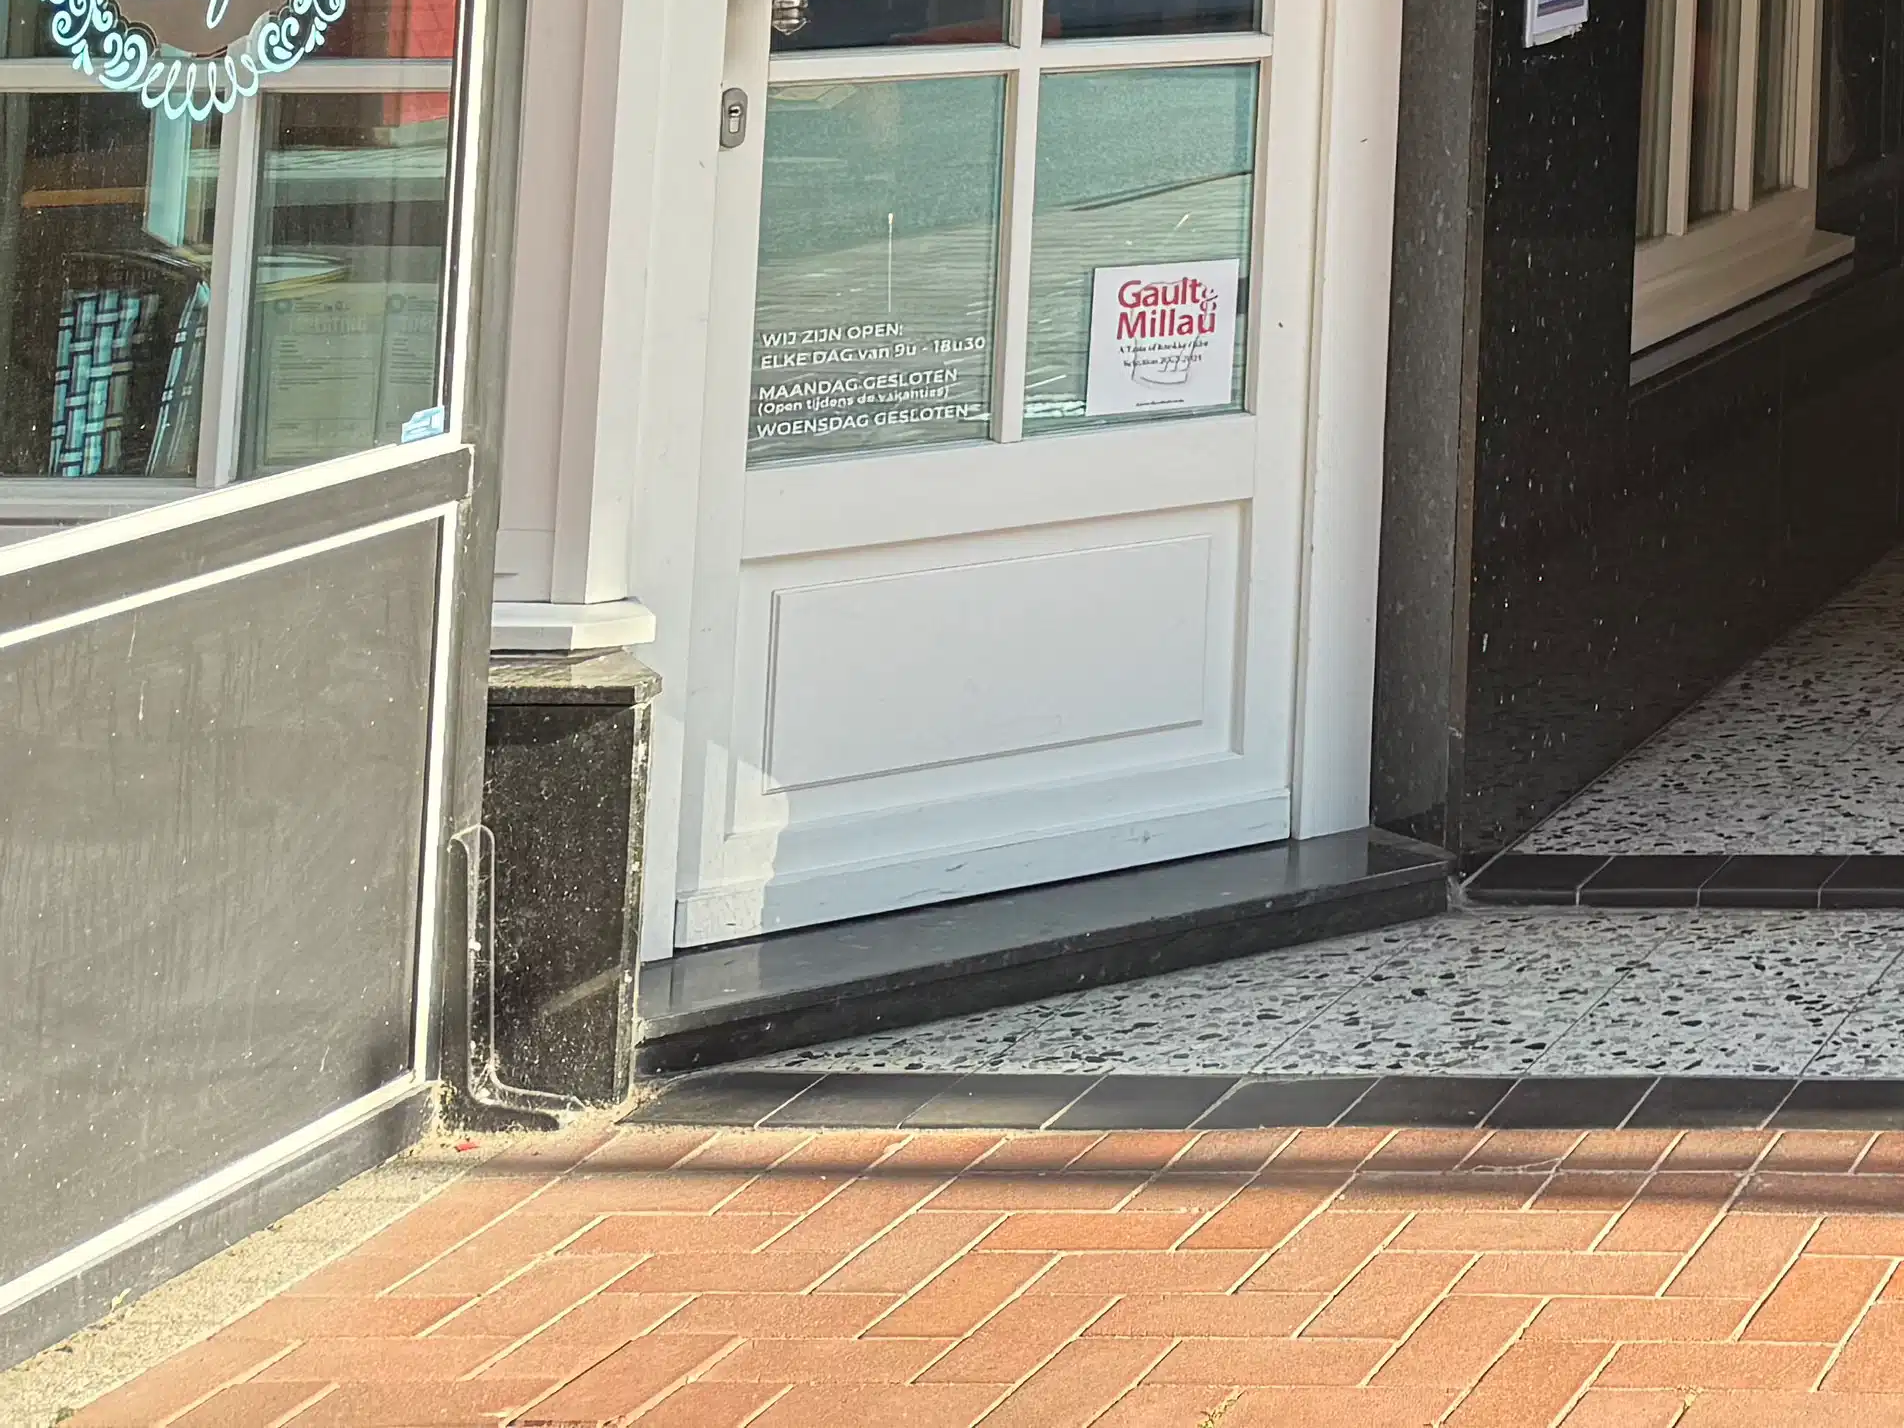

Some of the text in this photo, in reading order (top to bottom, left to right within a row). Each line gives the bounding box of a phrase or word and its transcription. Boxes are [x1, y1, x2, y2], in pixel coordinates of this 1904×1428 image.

[1117, 277, 1200, 309] Gault
[762, 332, 797, 348] WIJ
[801, 327, 842, 345] ZIJN
[1116, 308, 1216, 341] Millau
[760, 352, 808, 370] ELKE
[812, 348, 853, 365] DAG
[858, 346, 890, 361] van
[933, 336, 986, 354] 18u30
[758, 367, 958, 401] MAANDAG GESLOTEN
[756, 404, 969, 438] WOENSDAG GESLOTEN
